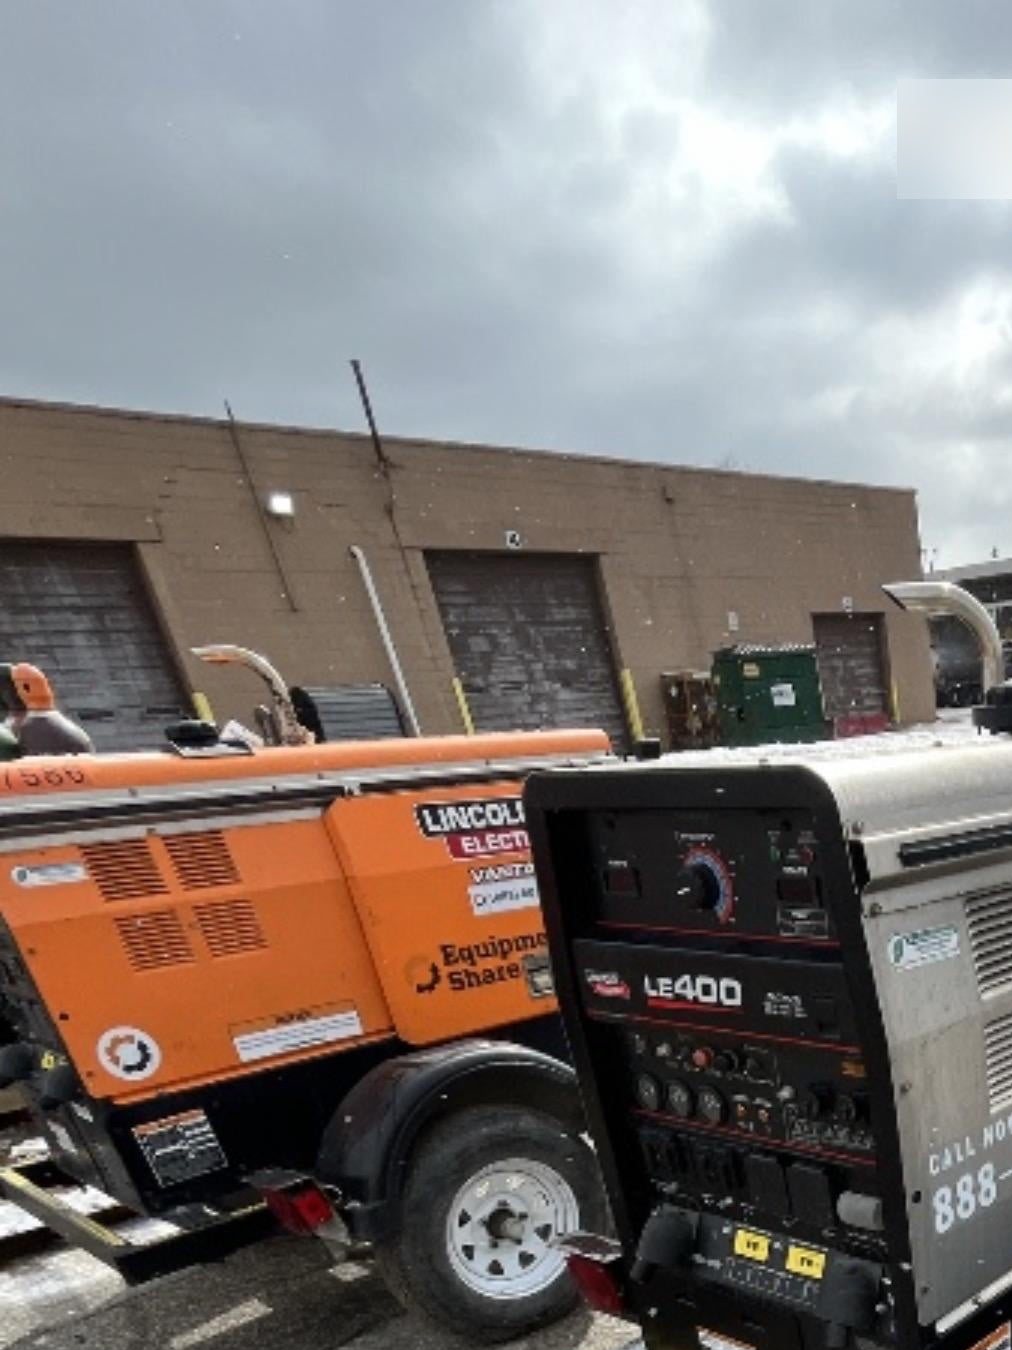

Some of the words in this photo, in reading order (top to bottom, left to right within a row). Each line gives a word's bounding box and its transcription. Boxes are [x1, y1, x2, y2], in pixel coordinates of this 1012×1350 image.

[421, 800, 526, 832] LINCOL
[447, 962, 522, 990] Share
[643, 974, 743, 1006] LE400
[928, 1135, 977, 1177] CALL
